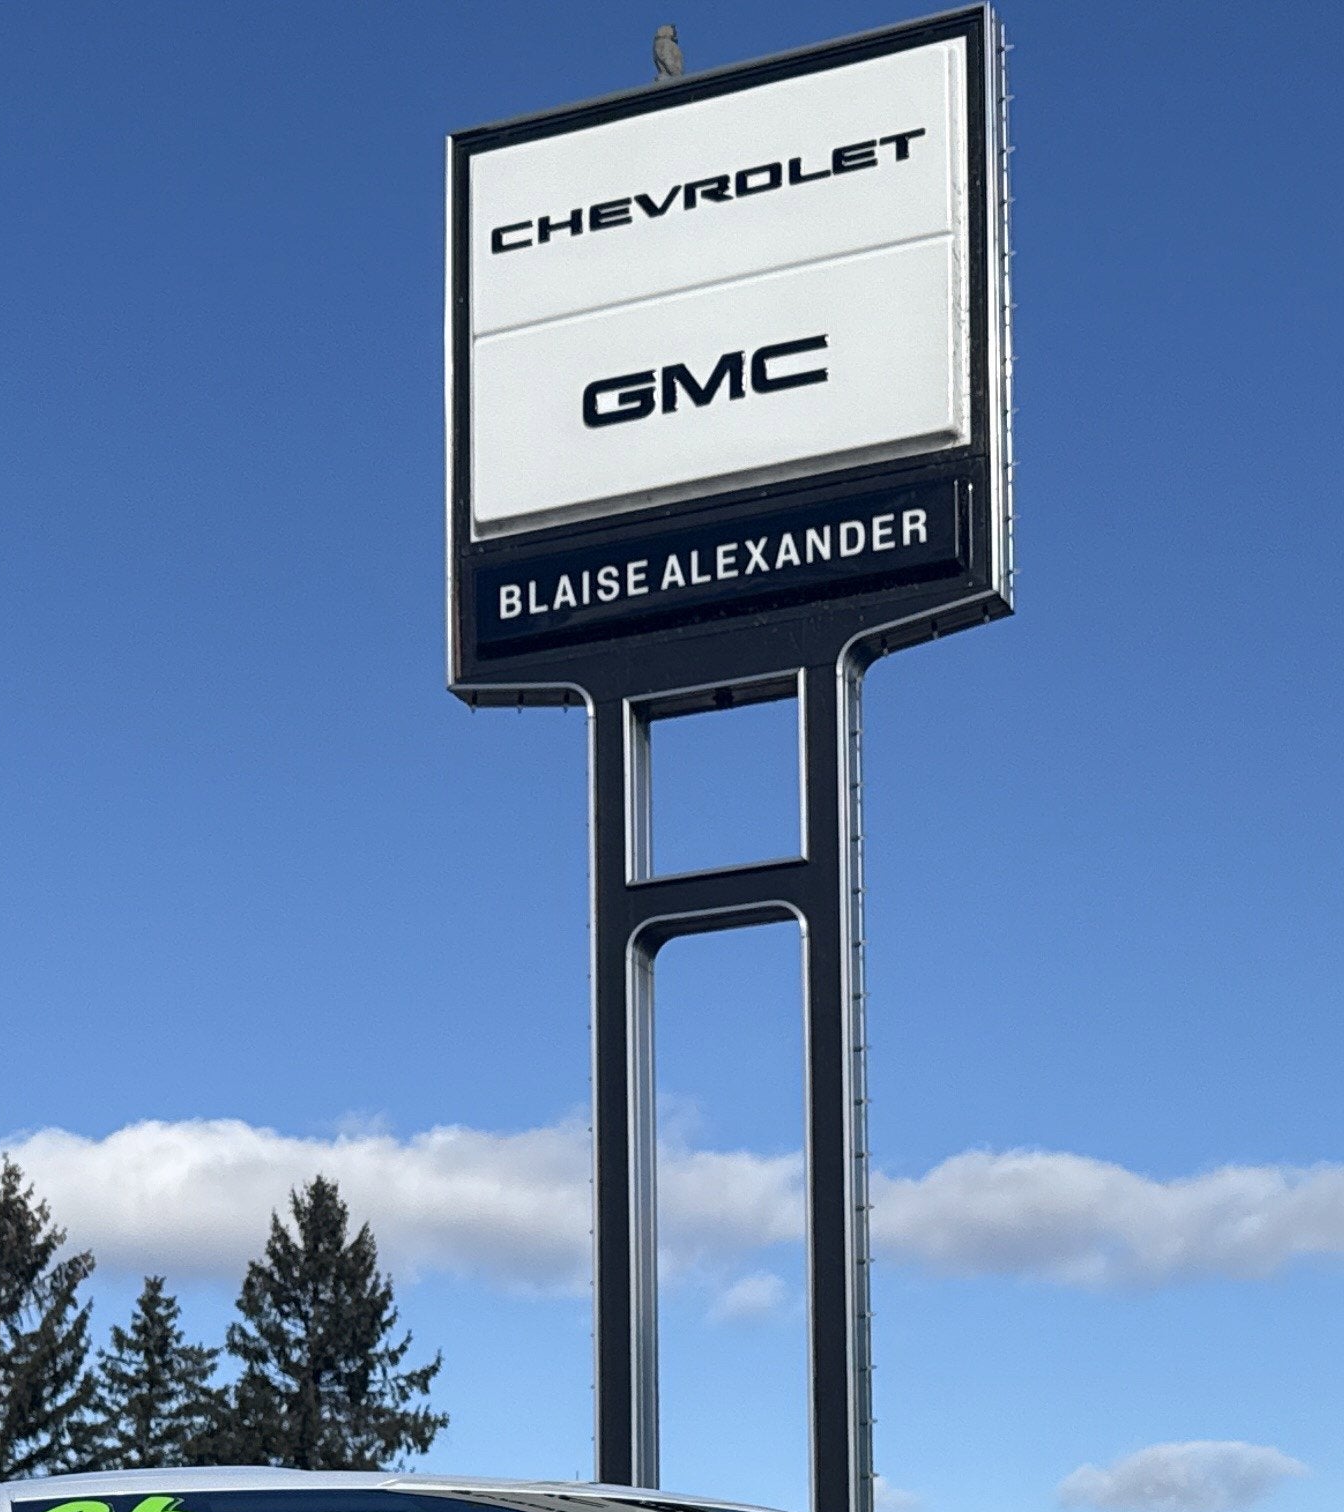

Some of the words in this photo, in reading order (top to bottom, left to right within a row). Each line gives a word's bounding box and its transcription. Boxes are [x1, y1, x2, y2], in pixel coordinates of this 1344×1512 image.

[491, 128, 926, 254] CHEVROLET
[583, 334, 829, 428] GMC
[498, 559, 649, 621] BLAISE
[660, 508, 928, 590] ALEXANDER
